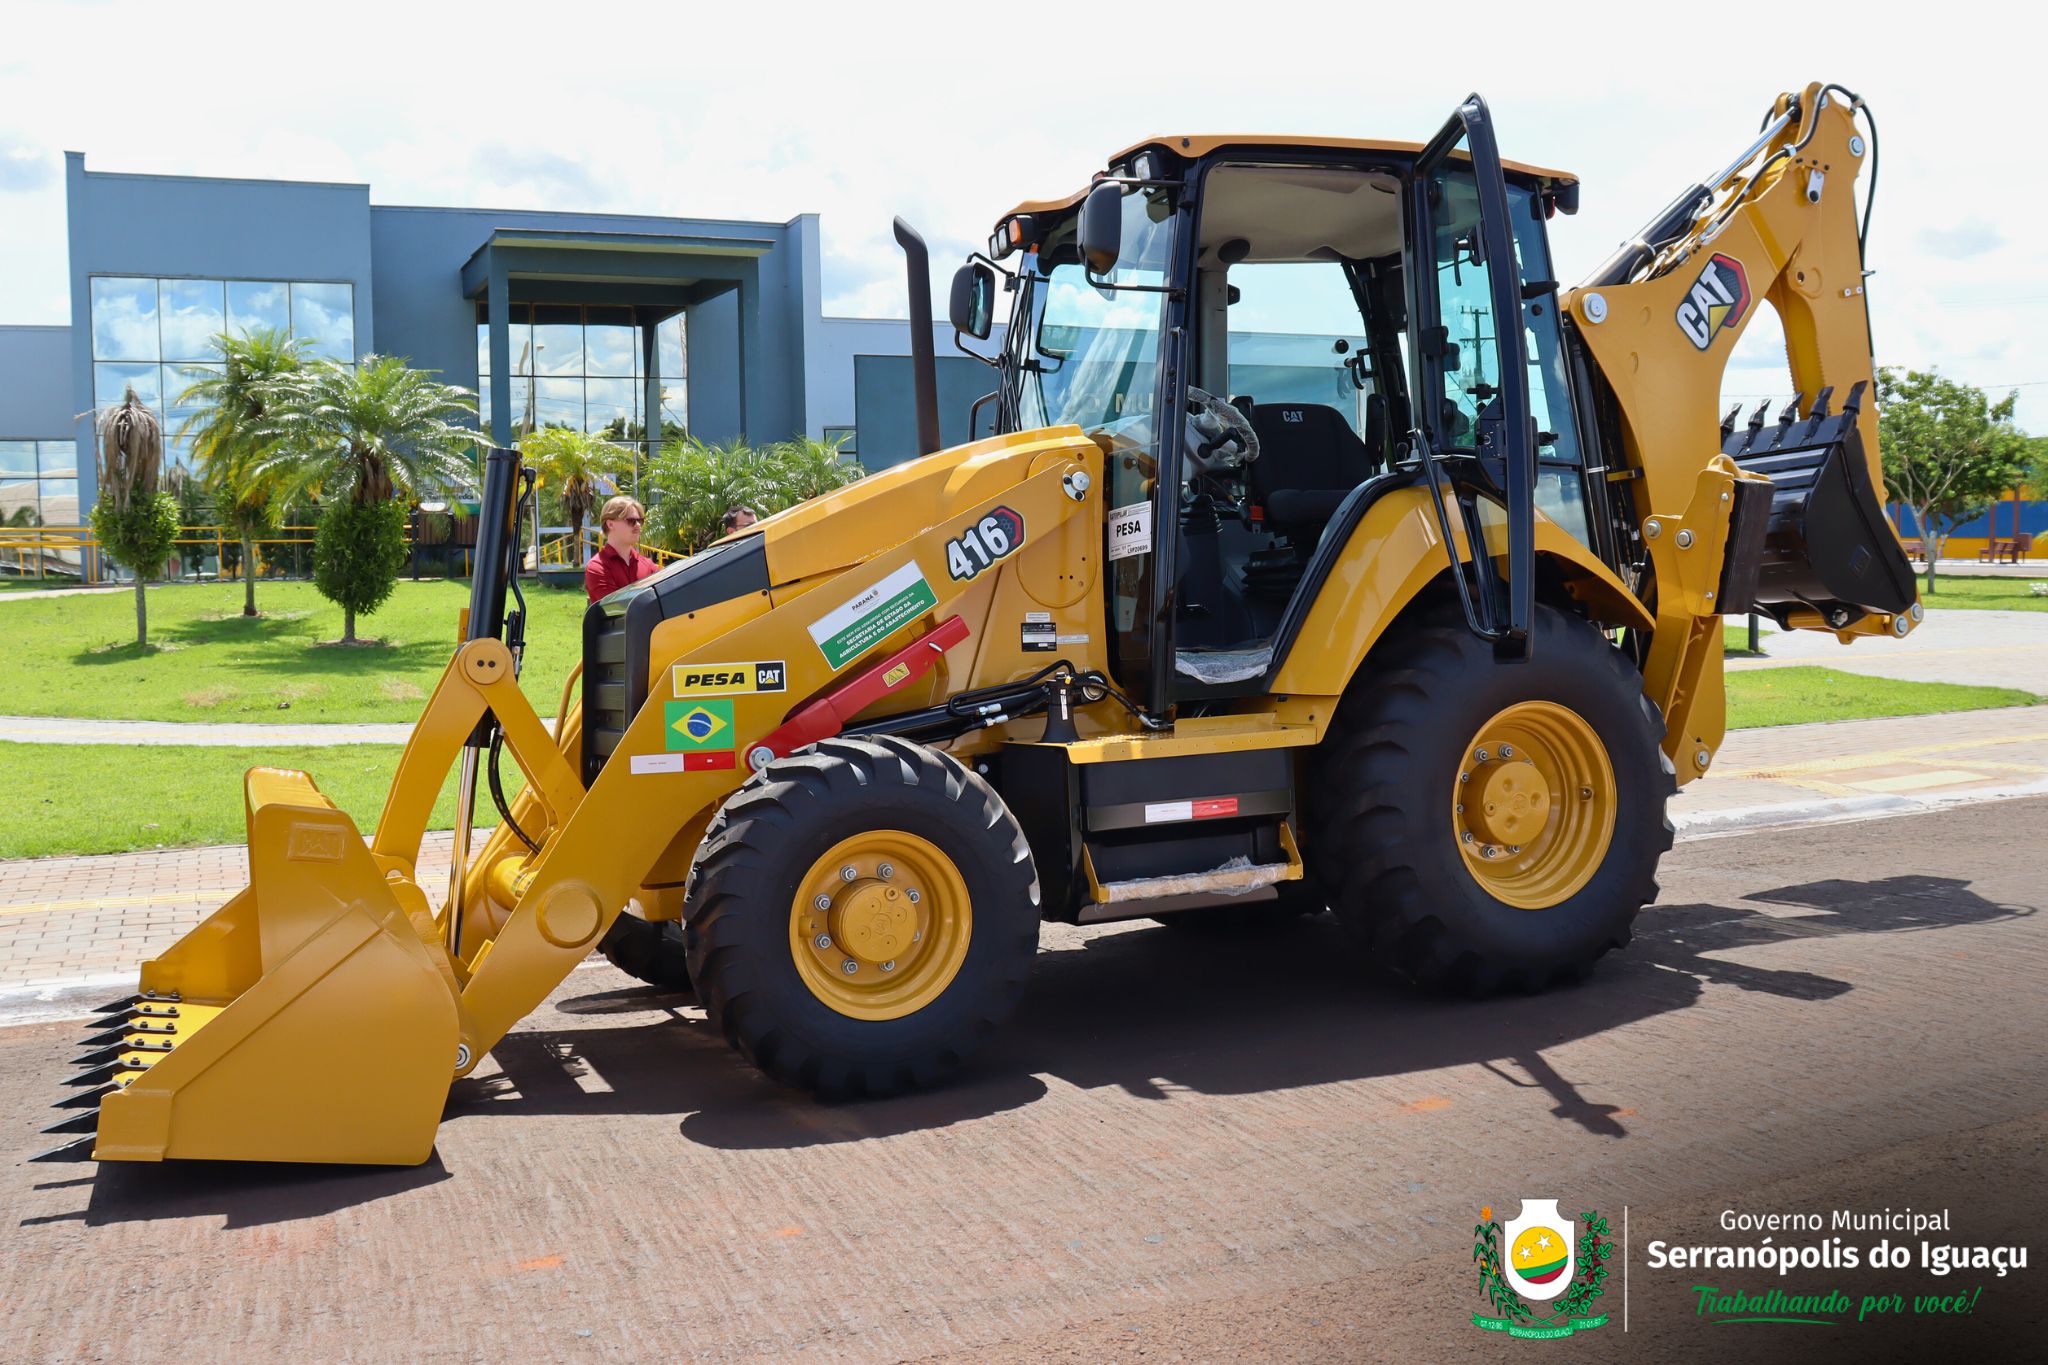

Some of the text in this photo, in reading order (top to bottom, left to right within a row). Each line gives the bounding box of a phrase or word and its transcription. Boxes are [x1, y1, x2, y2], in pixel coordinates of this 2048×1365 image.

[1677, 261, 1736, 349] CAT
[1283, 411, 1303, 423] CAT
[948, 517, 1009, 577] 416
[1117, 520, 1141, 538] PESA
[838, 633, 873, 658] AGRICULTURA
[876, 625, 885, 633] DO
[884, 599, 925, 627] ABASTECIMENTO
[846, 623, 876, 645] SECRETARIA
[883, 605, 903, 621] ESTADO
[903, 600, 911, 608] DA
[685, 670, 780, 687] PESA CAT
